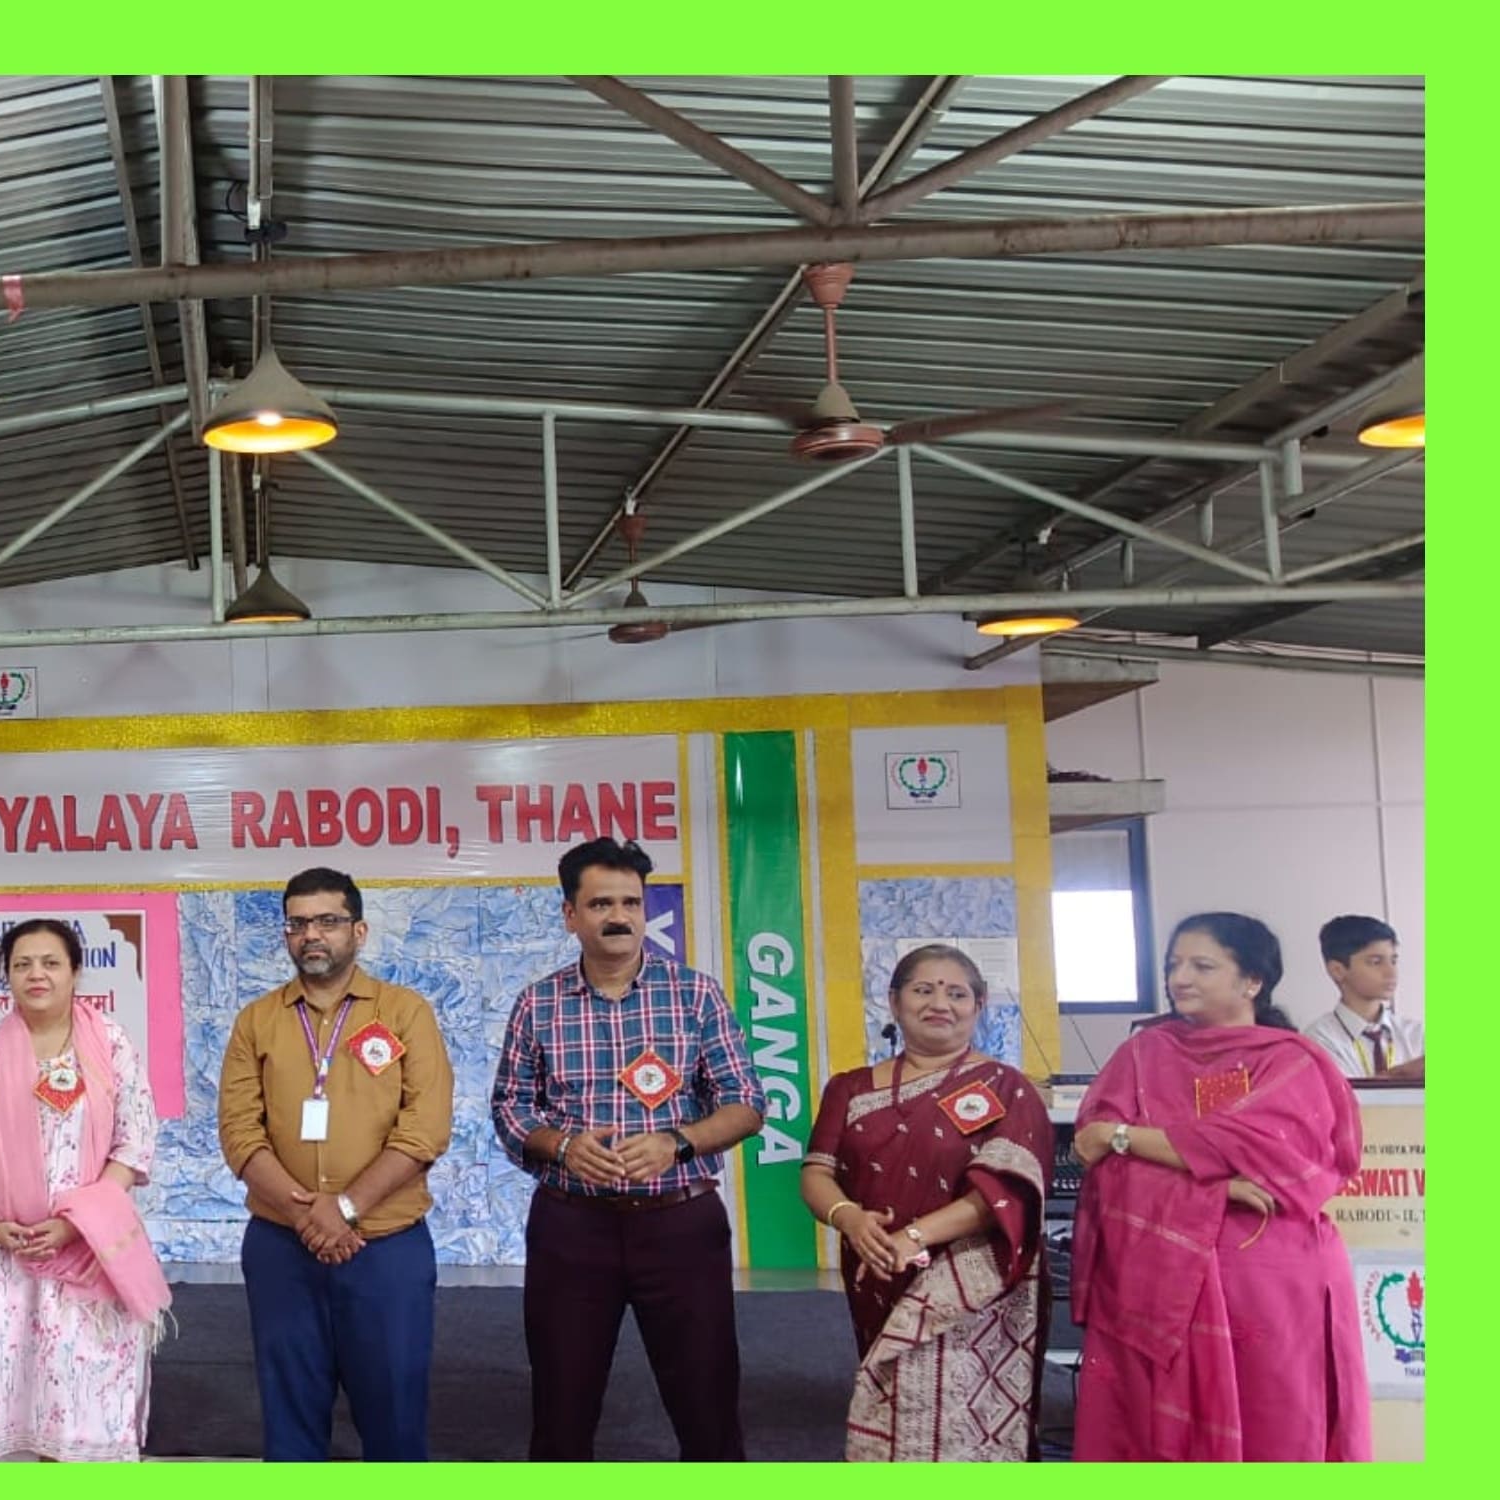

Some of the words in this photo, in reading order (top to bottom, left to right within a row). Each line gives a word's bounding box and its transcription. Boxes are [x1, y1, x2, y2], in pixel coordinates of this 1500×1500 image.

[231, 787, 460, 858] RABODI,
[477, 783, 677, 842] THANE
[746, 931, 803, 1166] GANGA
